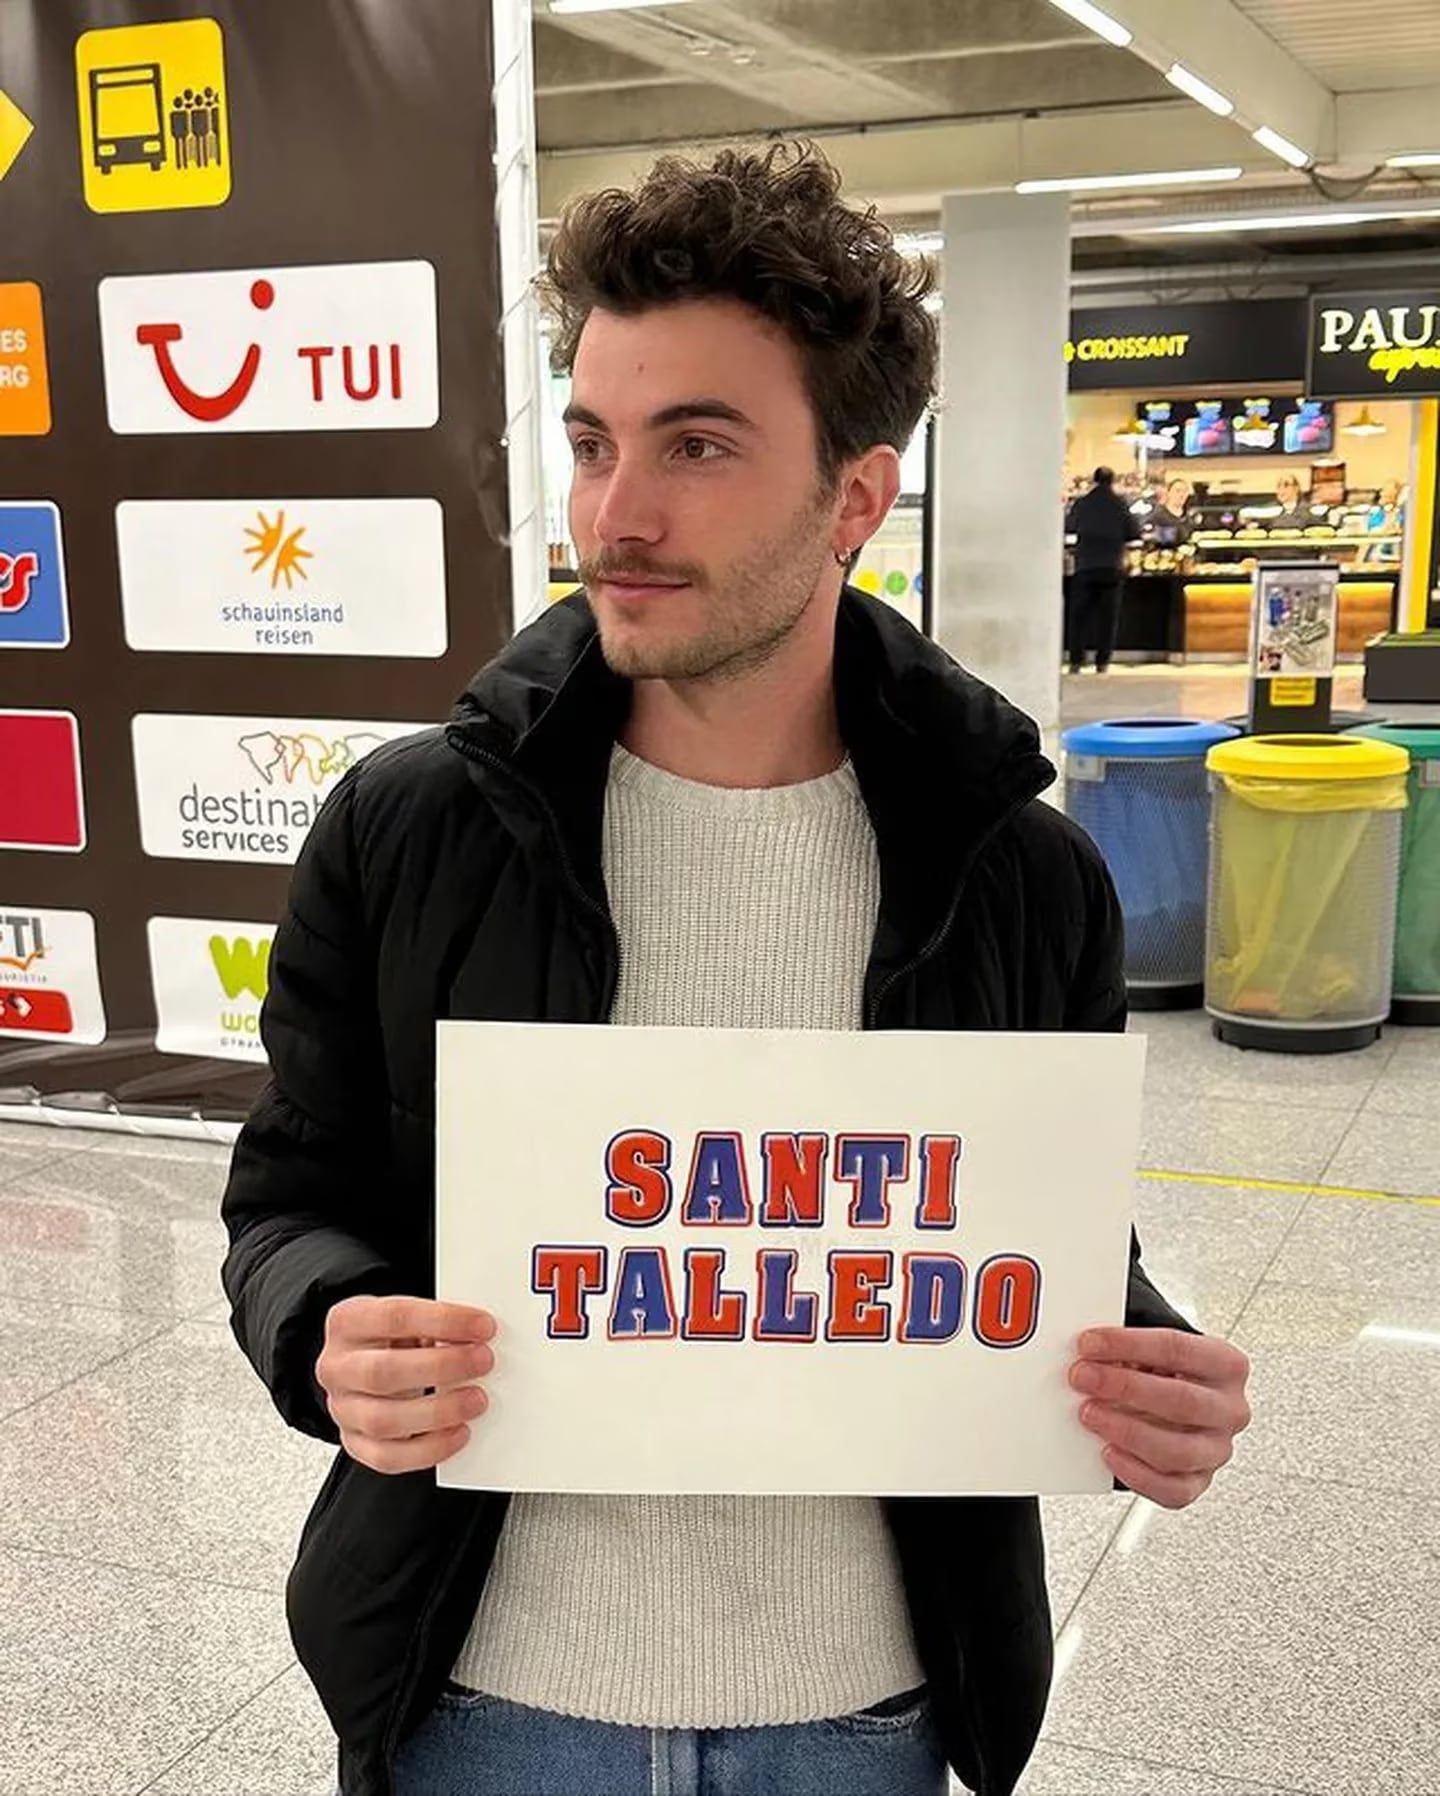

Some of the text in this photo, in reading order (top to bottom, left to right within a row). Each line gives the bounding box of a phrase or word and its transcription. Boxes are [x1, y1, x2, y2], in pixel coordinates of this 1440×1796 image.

[1077, 335, 1189, 361] CROISSANT
[1320, 305, 1440, 352] PAU
[297, 344, 402, 402] TUI
[222, 602, 344, 624] schauinsland
[256, 625, 313, 645] reisen
[182, 829, 289, 854] services
[0, 914, 45, 959] TI
[604, 1127, 961, 1230] SANTI
[531, 1244, 1042, 1350] TALLEDO
